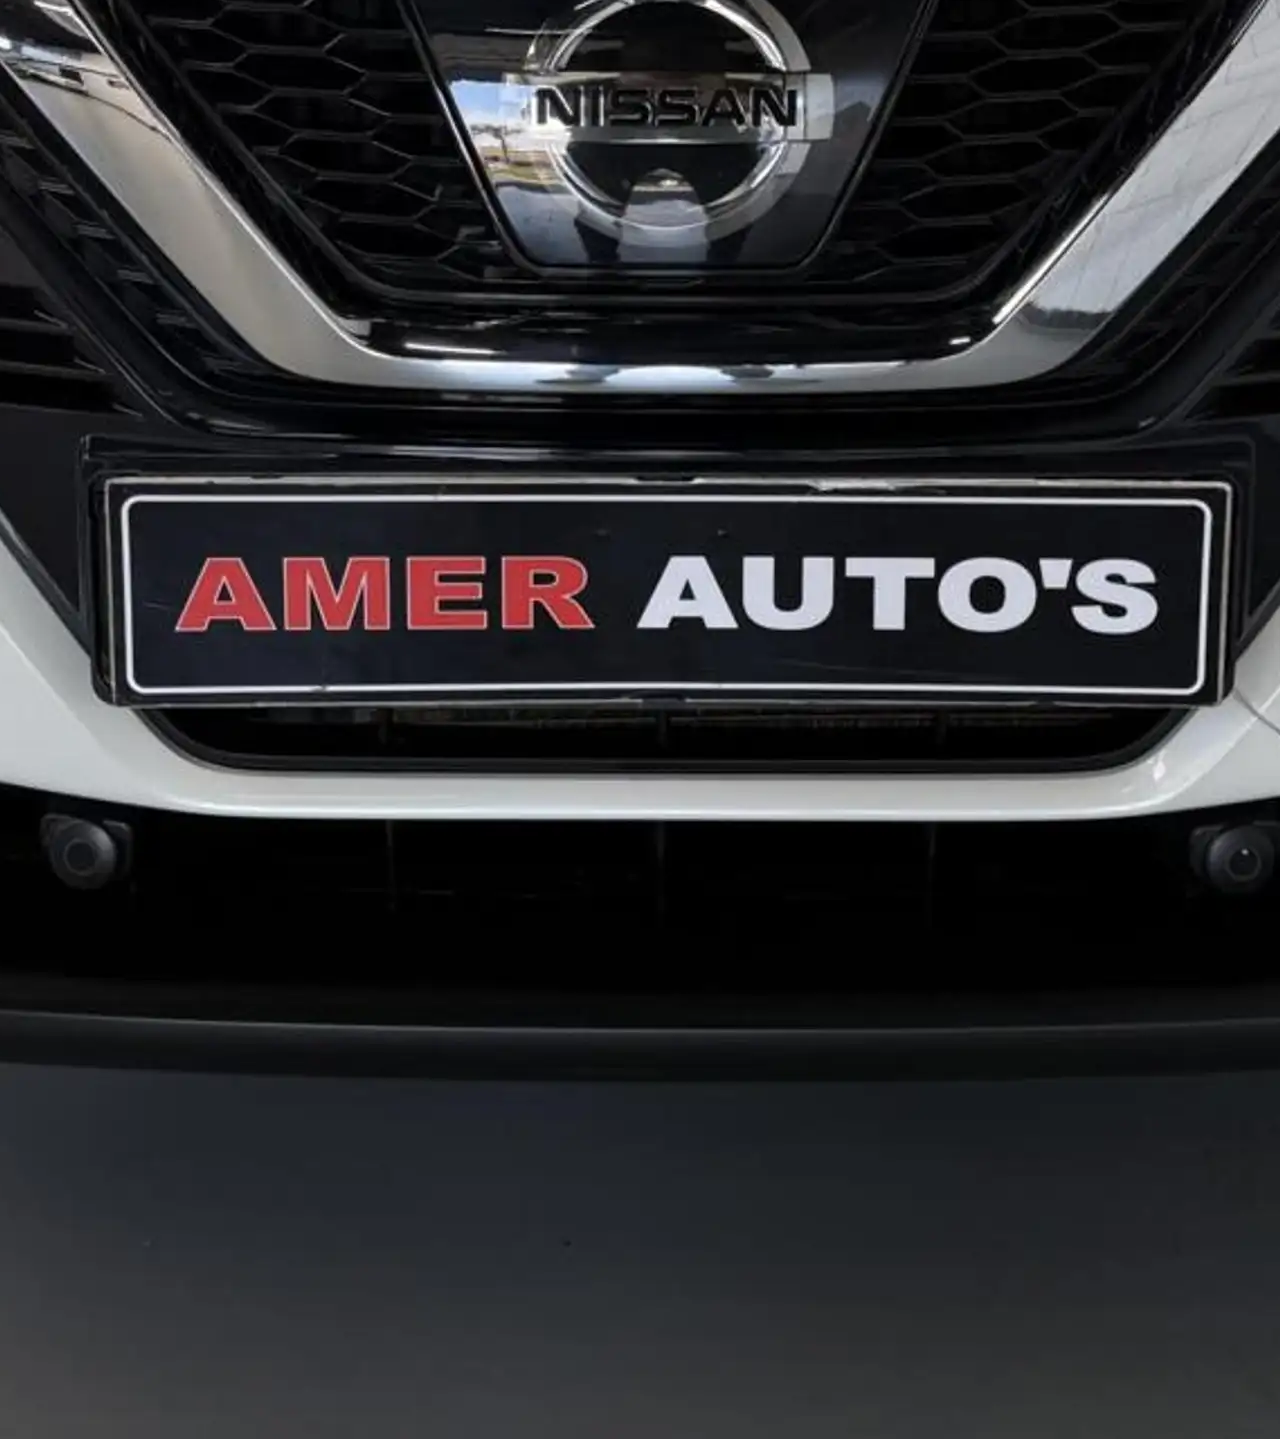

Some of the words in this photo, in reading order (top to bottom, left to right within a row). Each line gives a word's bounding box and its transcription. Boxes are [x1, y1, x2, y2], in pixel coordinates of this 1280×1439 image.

[535, 85, 799, 128] NISSAN
[175, 554, 596, 632] AMER
[636, 555, 1159, 634] AUTO'S
